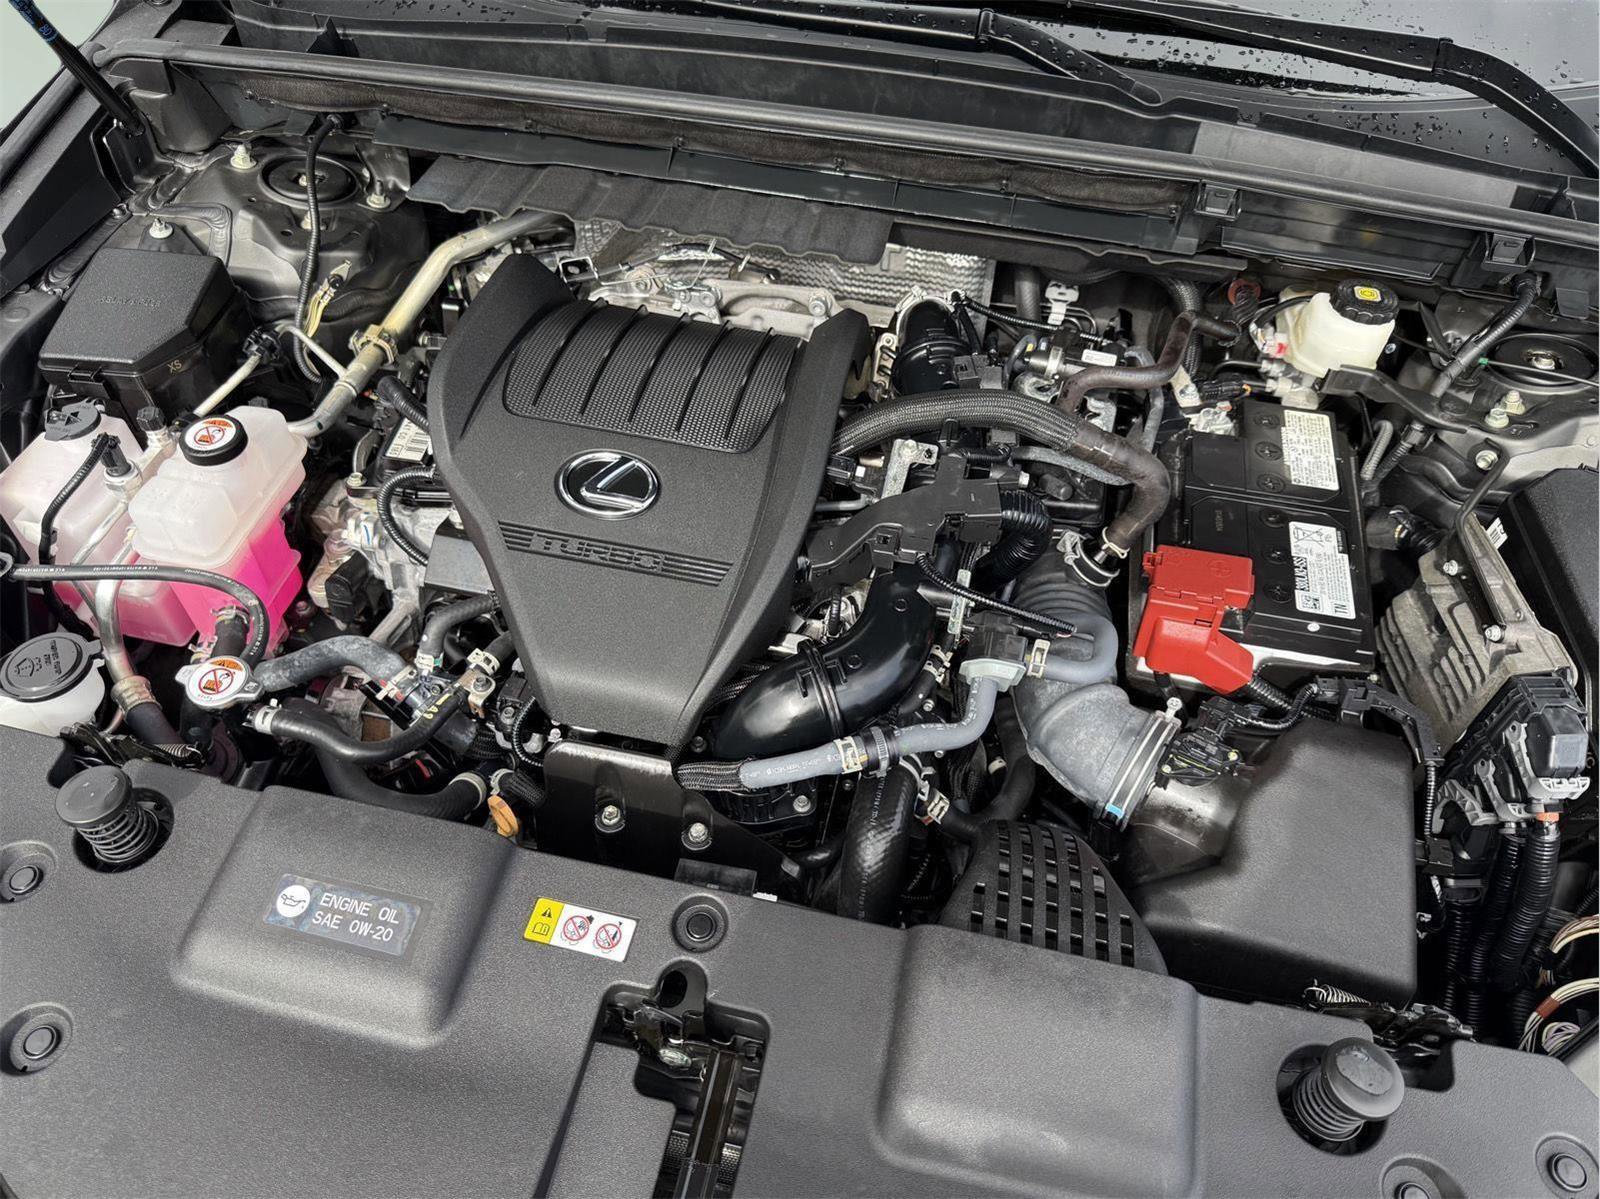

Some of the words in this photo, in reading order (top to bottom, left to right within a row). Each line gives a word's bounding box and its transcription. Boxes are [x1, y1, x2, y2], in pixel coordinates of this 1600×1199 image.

[529, 532, 665, 572] TURBO
[319, 892, 372, 917] ENGINE
[378, 907, 399, 924] OIL
[312, 911, 343, 929] SAE
[349, 919, 394, 942] 0W-20
